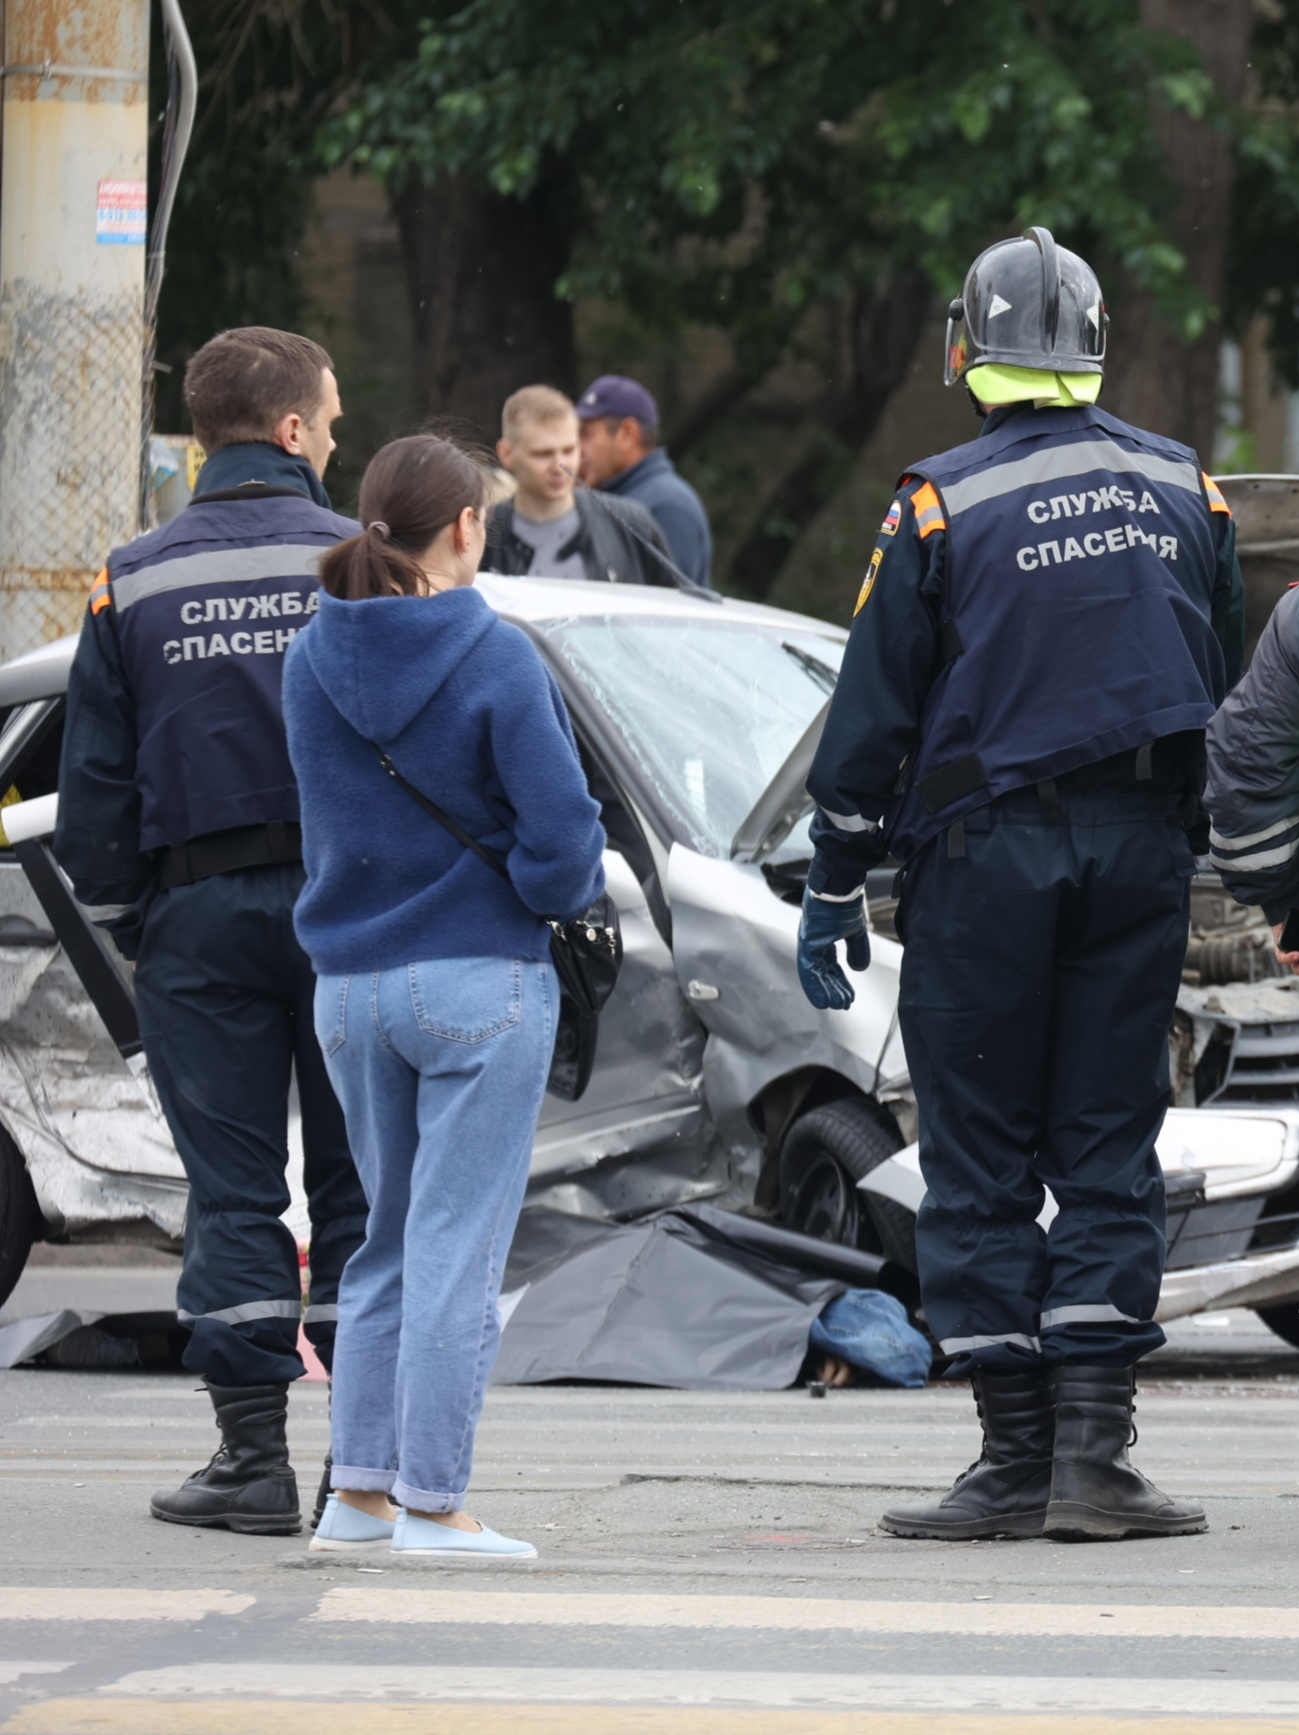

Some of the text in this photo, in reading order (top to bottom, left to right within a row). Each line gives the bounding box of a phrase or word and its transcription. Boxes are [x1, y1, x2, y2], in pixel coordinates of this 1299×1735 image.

[1027, 485, 1161, 524] СЛУЖБА
[180, 591, 319, 625] СЛУЖБА
[163, 628, 303, 665] СПАСЕН
